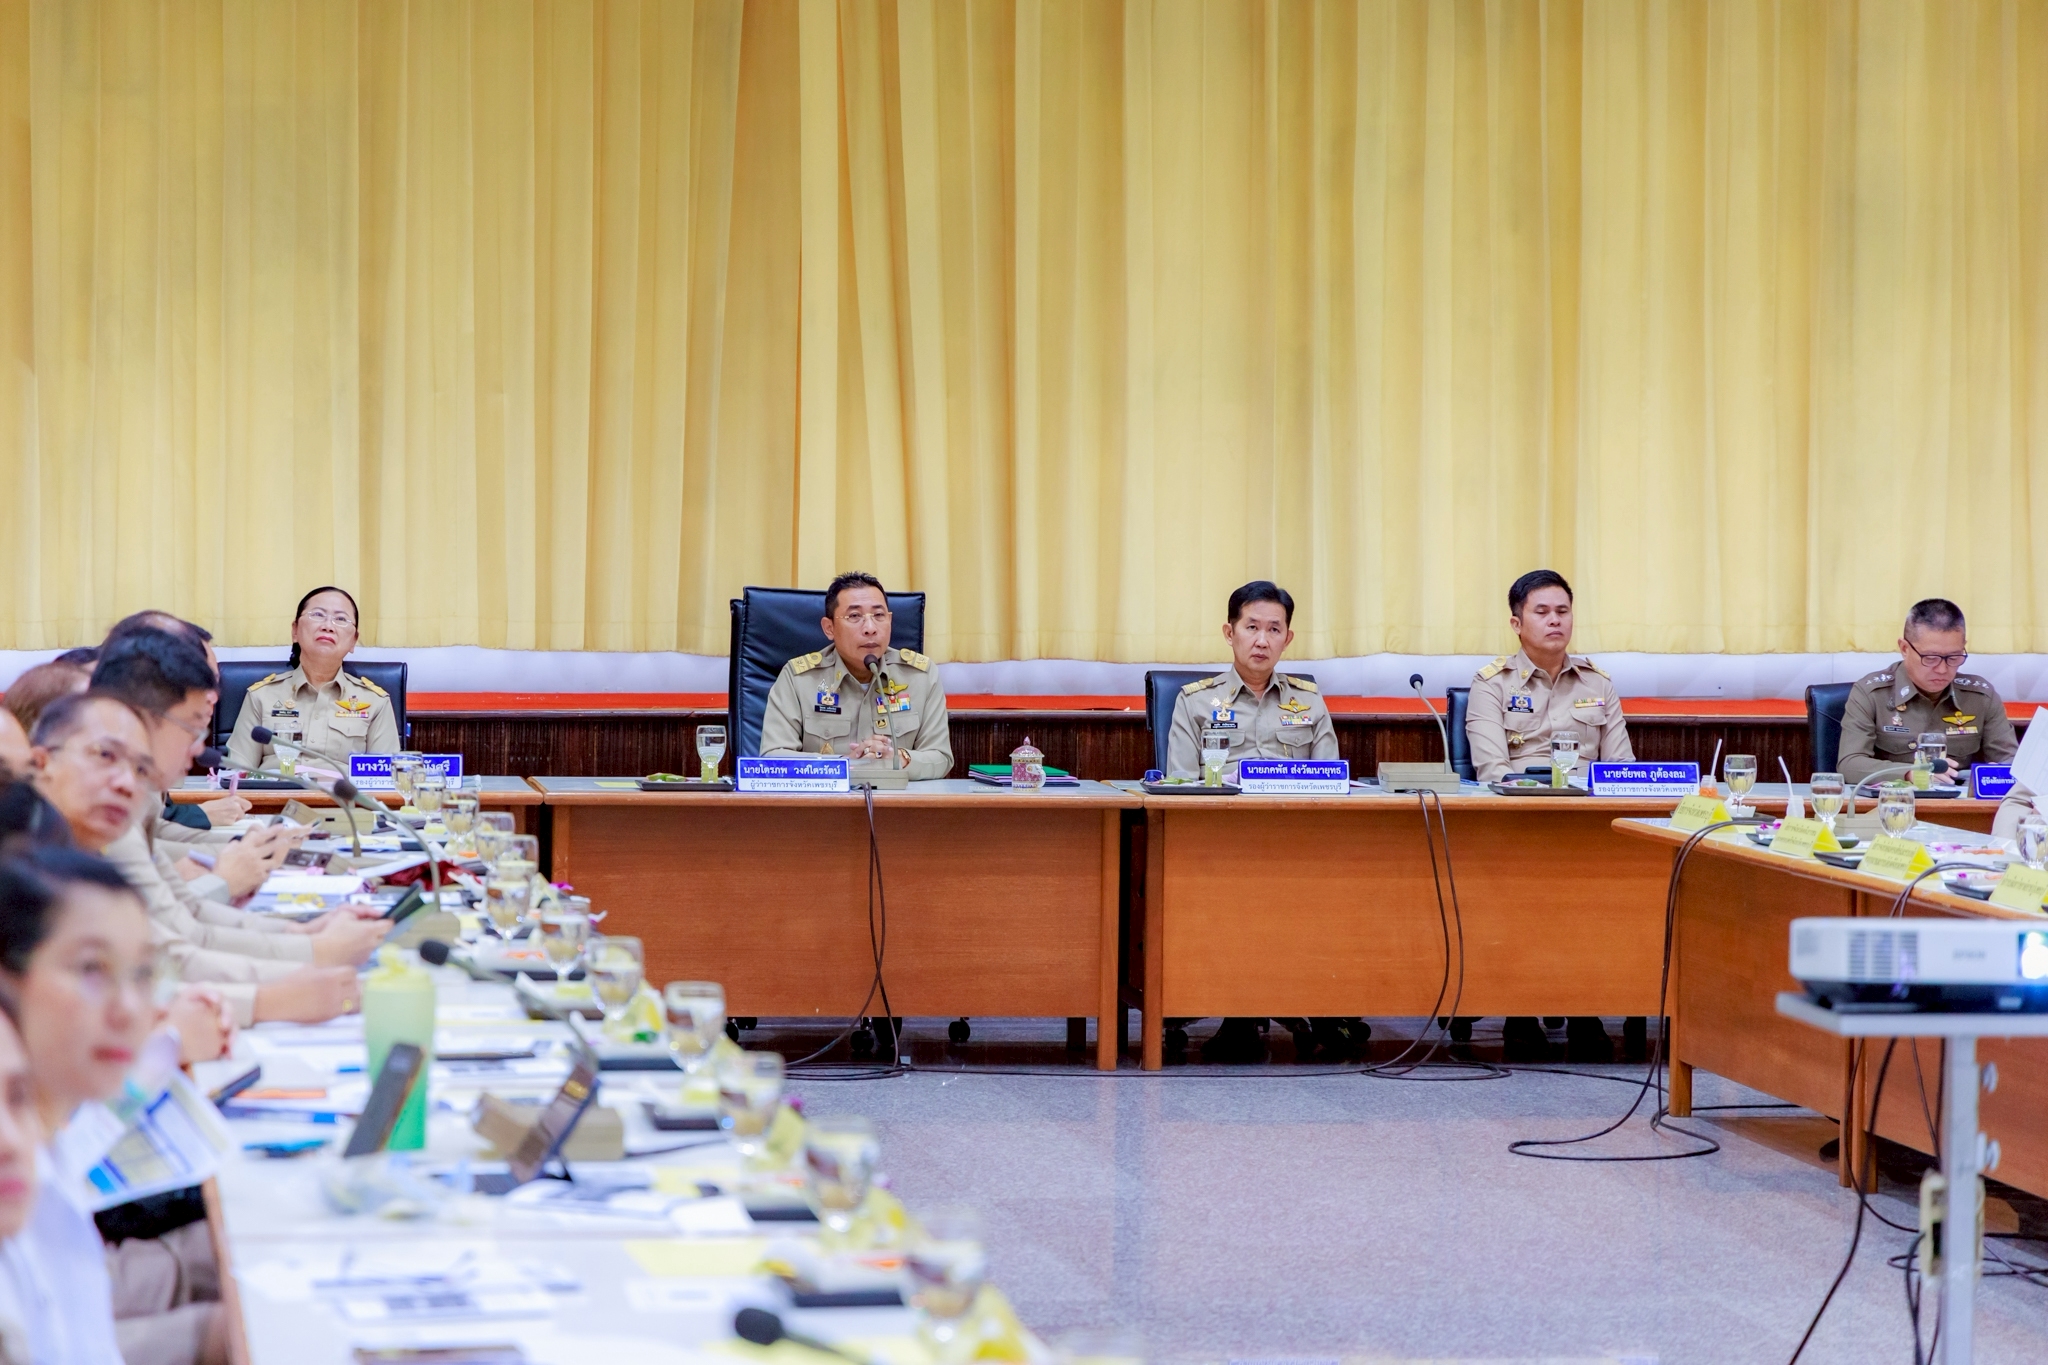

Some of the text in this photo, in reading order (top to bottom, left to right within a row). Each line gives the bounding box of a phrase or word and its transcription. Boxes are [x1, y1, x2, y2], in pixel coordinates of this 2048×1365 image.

[743, 763, 841, 775] นายไตรภพ วงศ์ไตรรัตน์
[1247, 763, 1341, 778] นายภคพัส ส่งวัฒนายุทธ
[1603, 767, 1647, 778] นายชัยพล
[750, 779, 837, 790] ผู้ว่าราชการจังหวัดเพชรบุรี
[1248, 782, 1342, 792] รองผู้ว่าราชการจังหวัดเพชรบุรี
[1598, 784, 1694, 795] รองผู้ว่าราชการจังหวัดเพชรบุรี
